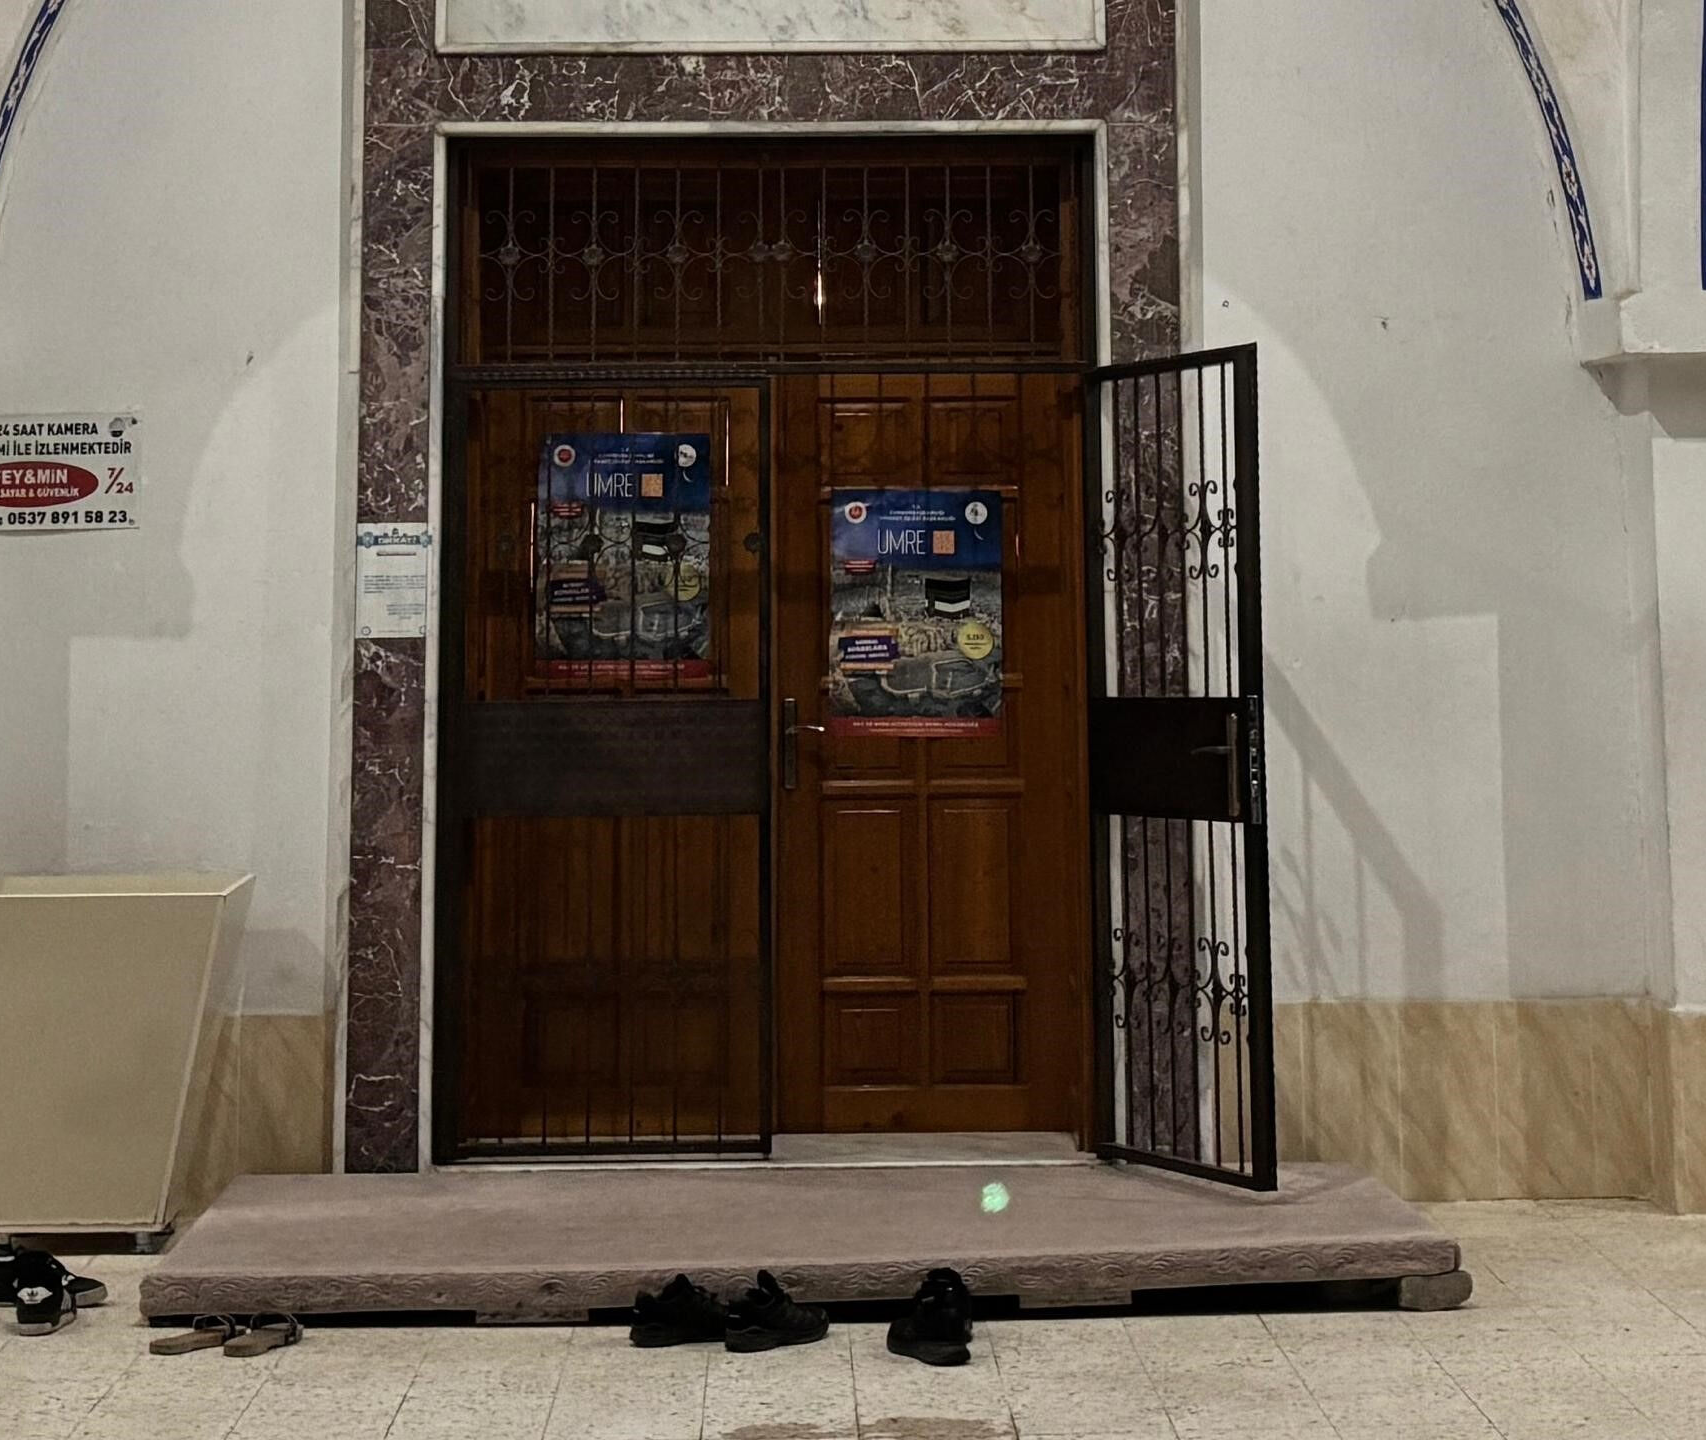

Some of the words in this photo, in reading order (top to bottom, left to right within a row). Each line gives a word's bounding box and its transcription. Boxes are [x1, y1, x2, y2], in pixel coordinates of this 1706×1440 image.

[12, 423, 44, 437] SAAT
[47, 422, 99, 436] KAMERA
[13, 440, 32, 456] İLE
[35, 438, 132, 456] İZLENMEKTEDİR
[586, 472, 634, 498] UMRE
[7, 511, 46, 525] 0537
[51, 511, 79, 524] 891
[84, 510, 104, 523] 58
[107, 510, 127, 523] 23
[877, 529, 926, 555] UMRE
